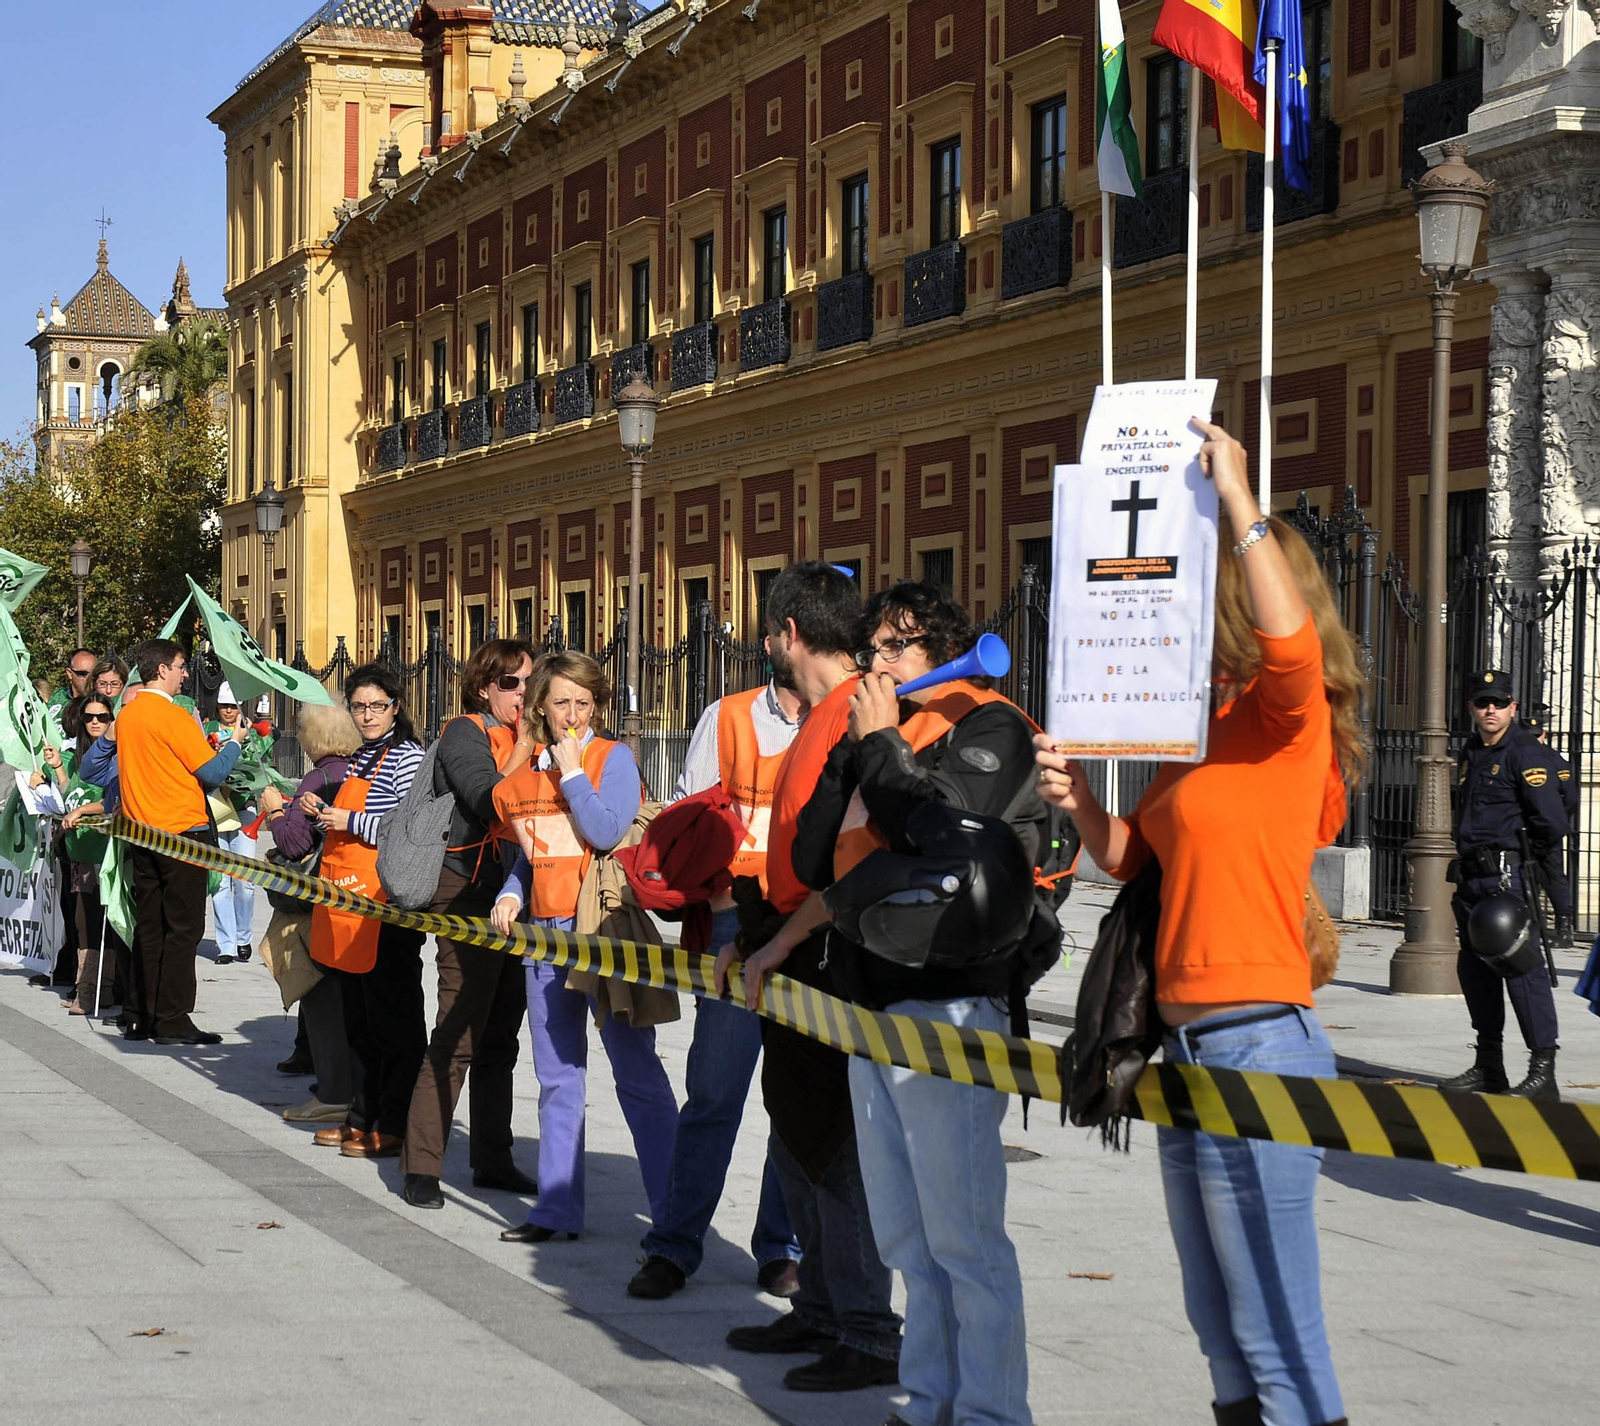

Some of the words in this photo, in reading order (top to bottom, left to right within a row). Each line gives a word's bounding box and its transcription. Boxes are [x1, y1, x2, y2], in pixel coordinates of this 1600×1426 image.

[1116, 427, 1138, 438] NO
[1155, 429, 1169, 437] LA
[1122, 454, 1133, 462] NI
[1139, 453, 1153, 462] AL
[1105, 465, 1170, 475] ENCHUFISMO
[1101, 611, 1117, 620] NO
[1127, 611, 1134, 620] A
[1141, 610, 1158, 619] LA
[1107, 666, 1123, 675] DE
[1133, 666, 1148, 674] LA
[1055, 694, 1095, 703] JUNTA
[1102, 693, 1117, 703] DE
[15, 871, 38, 901] LEY
[334, 875, 359, 888] PARA
